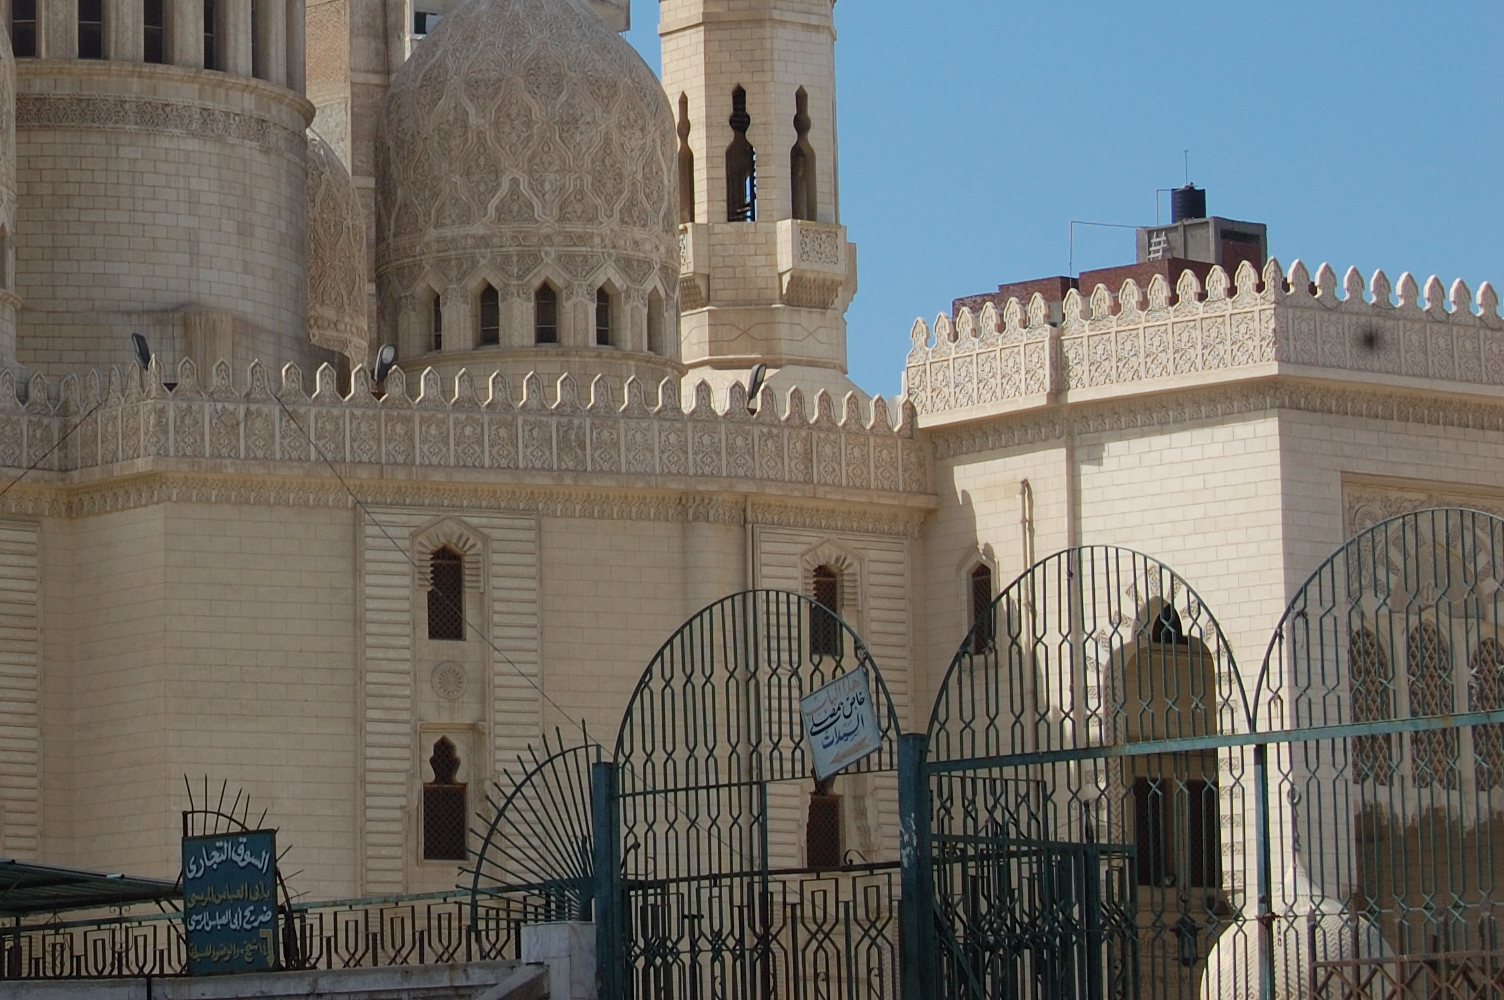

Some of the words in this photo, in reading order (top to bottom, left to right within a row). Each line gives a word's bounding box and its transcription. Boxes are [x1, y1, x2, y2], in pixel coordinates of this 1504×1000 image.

[843, 691, 865, 719] خاص
[821, 712, 865, 749] السيدات
[232, 836, 272, 875] السوق
[215, 881, 249, 905] العباس
[243, 905, 273, 930] ضريح
